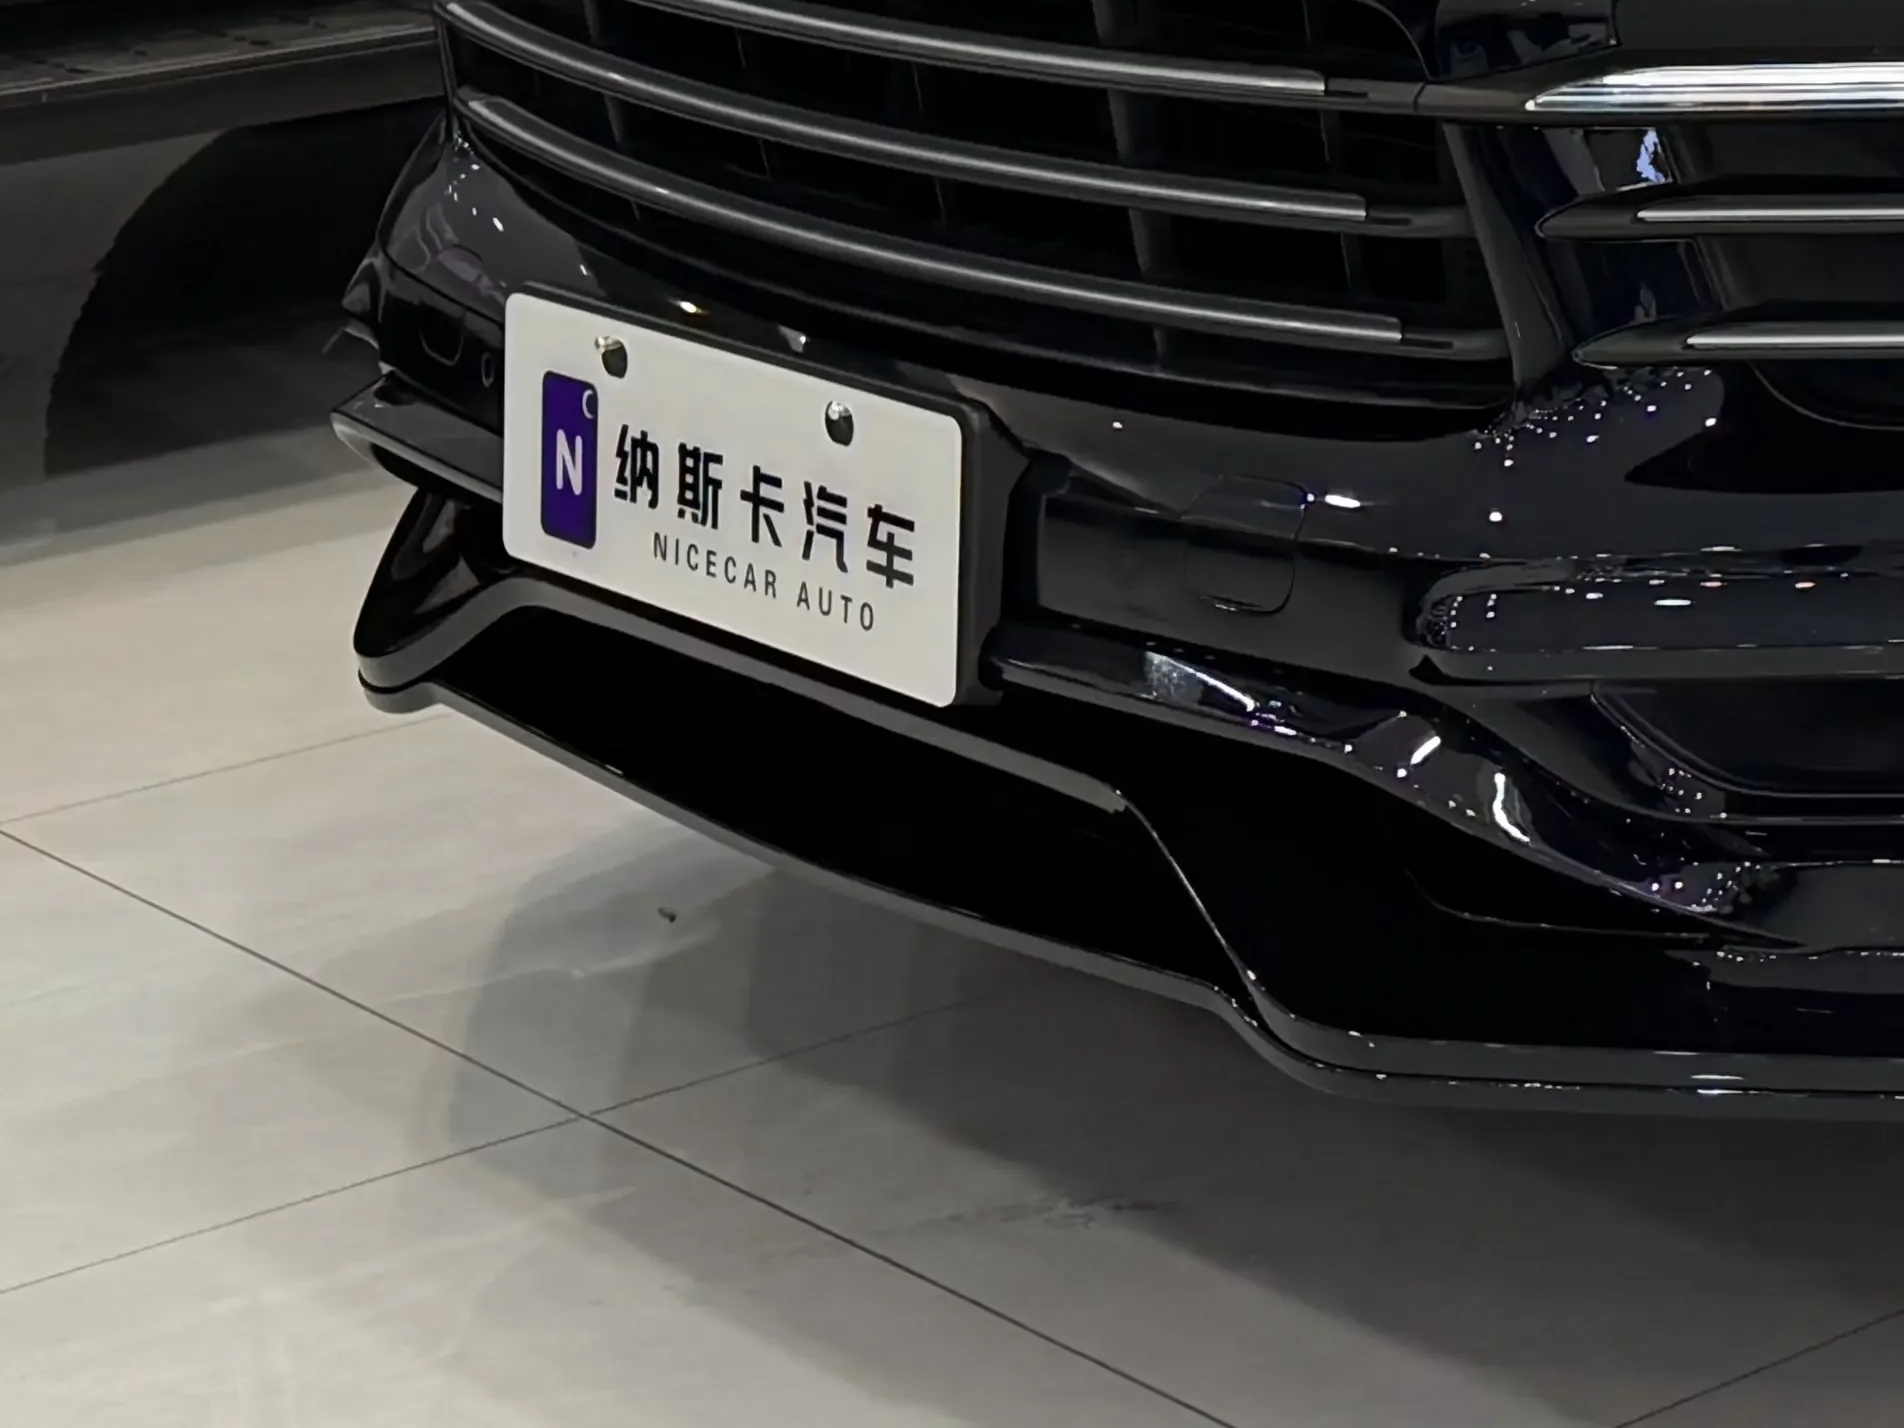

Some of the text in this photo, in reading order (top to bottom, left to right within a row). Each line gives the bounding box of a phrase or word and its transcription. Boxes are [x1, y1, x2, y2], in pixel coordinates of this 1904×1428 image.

[555, 428, 583, 497] N
[613, 423, 916, 589] 纳斯卡汽车
[652, 531, 875, 632] NICECAR AUTO
